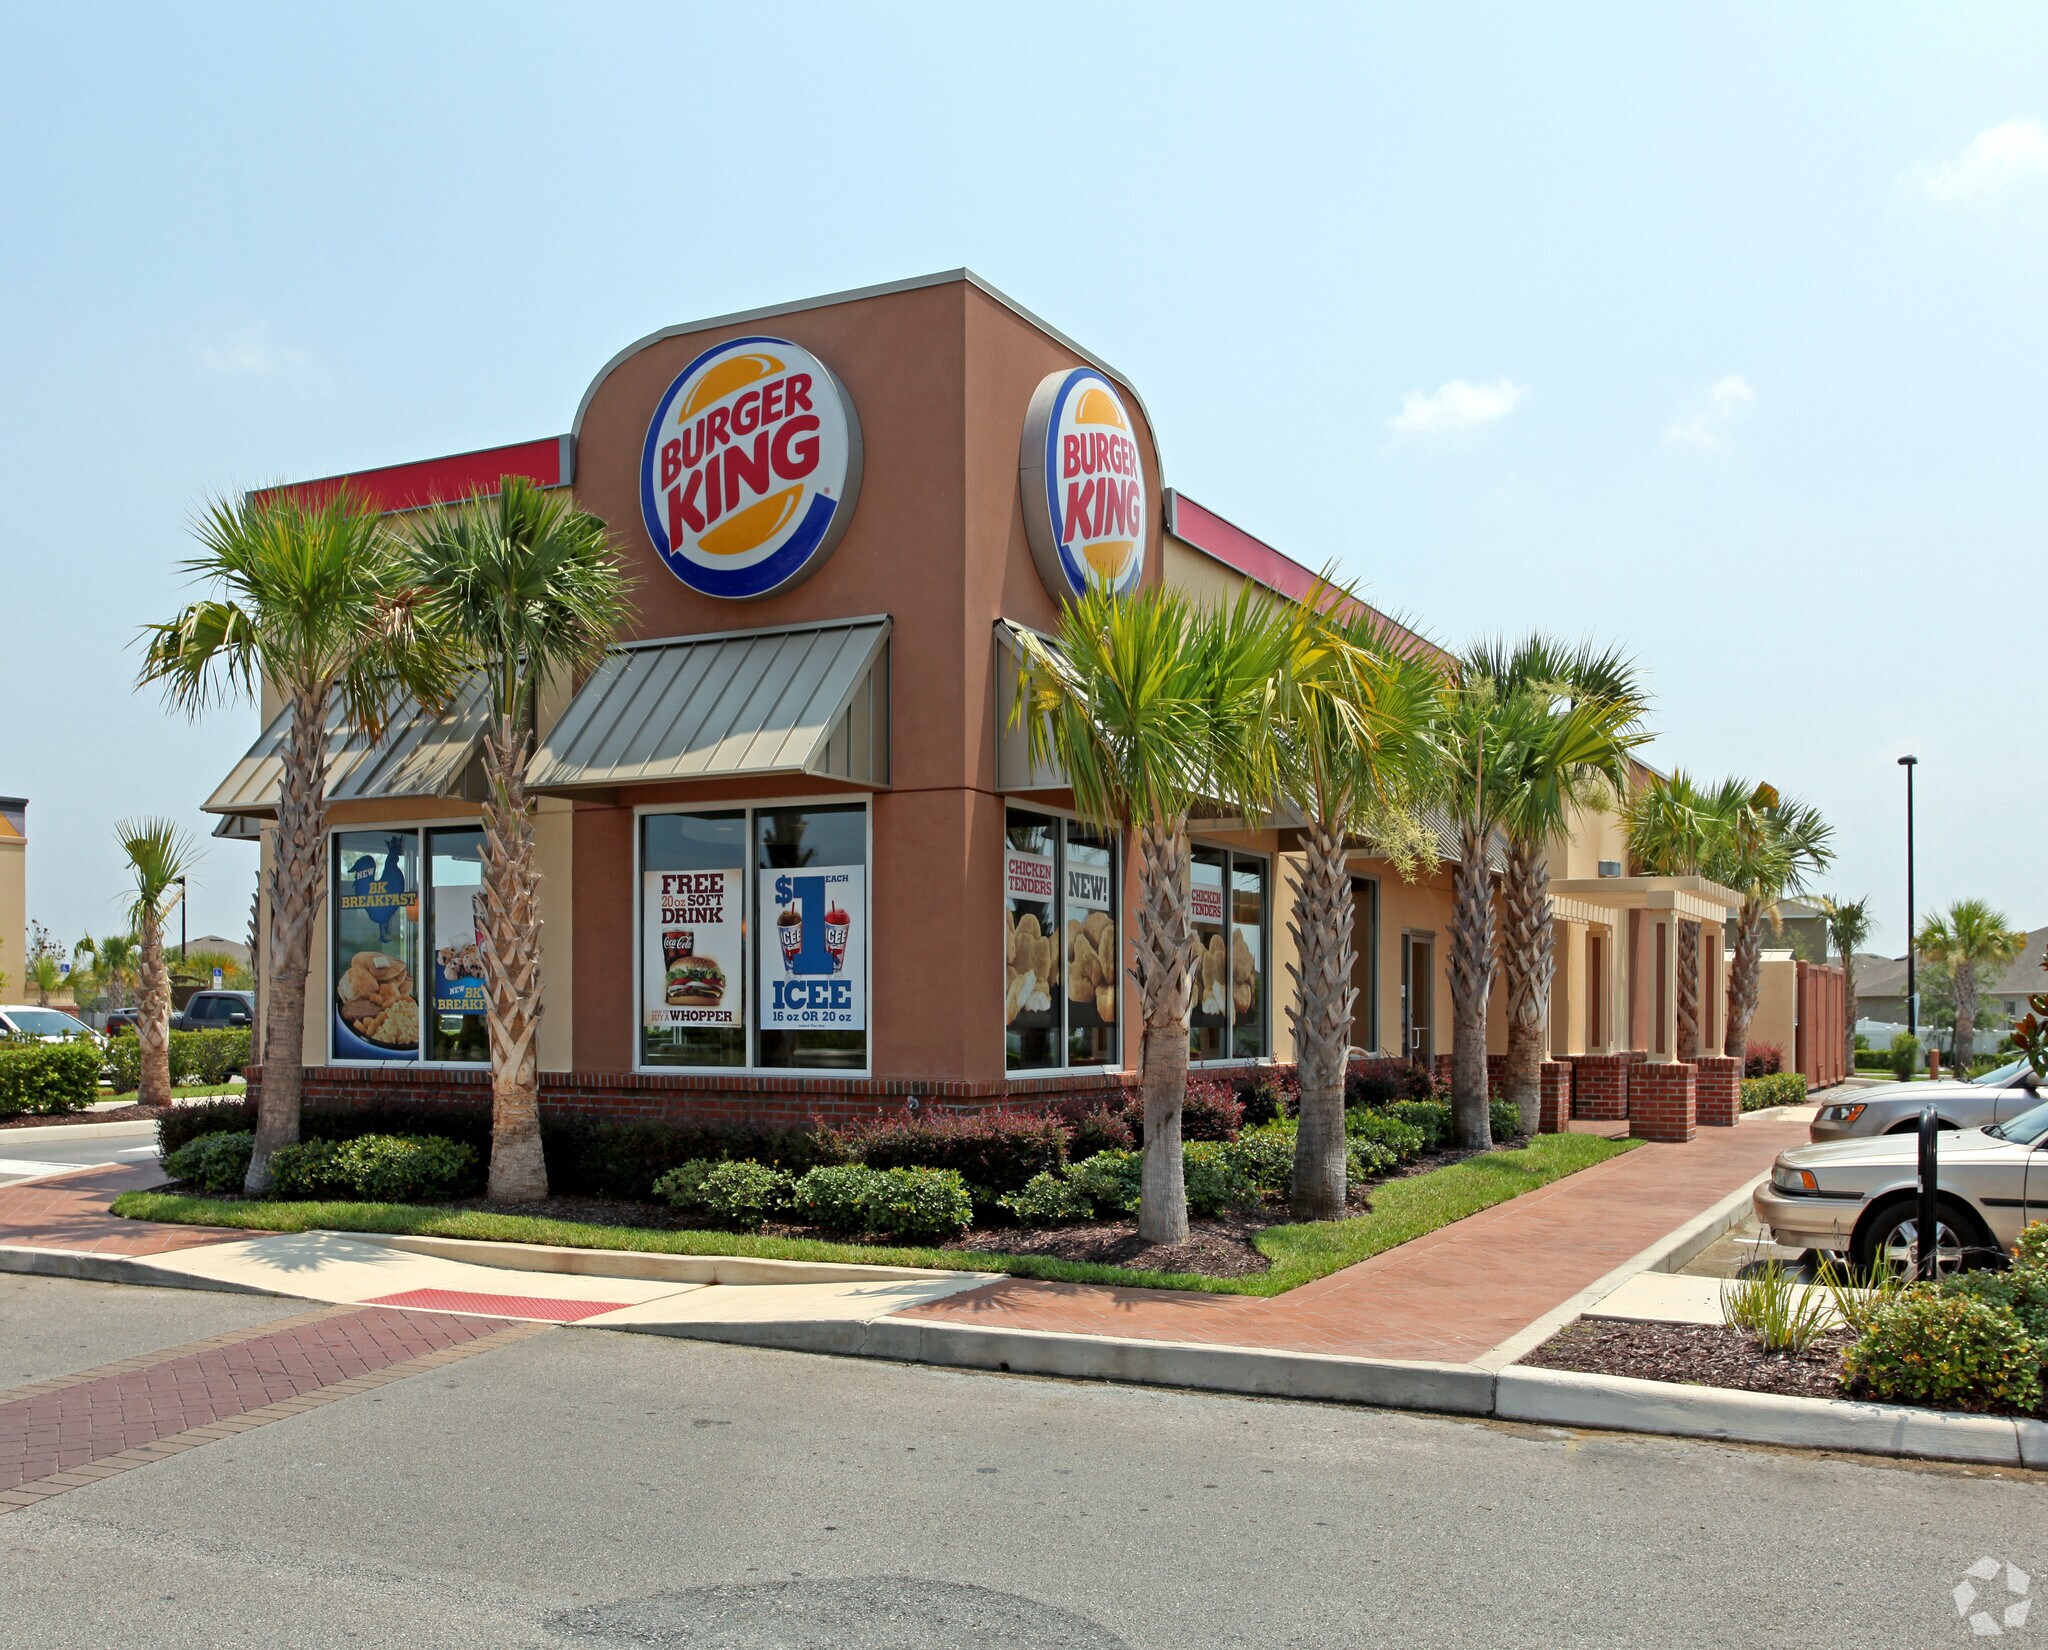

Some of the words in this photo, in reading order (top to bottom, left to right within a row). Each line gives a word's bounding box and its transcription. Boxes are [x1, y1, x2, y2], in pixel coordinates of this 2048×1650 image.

[661, 373, 813, 492] BURGER
[1063, 432, 1138, 480] BURGER
[667, 414, 820, 554] KING
[1063, 477, 1140, 544] KING
[357, 867, 374, 879] NEW
[1008, 858, 1052, 879] CHICKEN
[369, 881, 388, 894] BK
[661, 873, 724, 895] FREE
[1008, 875, 1052, 896] TENDERS
[1068, 871, 1107, 902] NEW!
[341, 893, 416, 908] BREAKFAST
[662, 895, 674, 907] 20
[687, 894, 724, 906] SOFT
[1191, 889, 1221, 904] CHICKEN
[661, 907, 724, 924] DRINK
[1191, 902, 1221, 918] TENDERS
[775, 874, 834, 974] $1
[825, 928, 847, 945] ICEE
[449, 985, 465, 995] NEW
[464, 987, 482, 998] BK
[772, 980, 852, 1010] ICEE
[437, 998, 486, 1010] BREAKF
[669, 1010, 733, 1022] WHOPPER
[773, 1011, 784, 1022] 16
[786, 1014, 799, 1022] oz
[801, 1011, 819, 1022] OR
[822, 1011, 836, 1022] 20
[838, 1014, 852, 1022] oz
